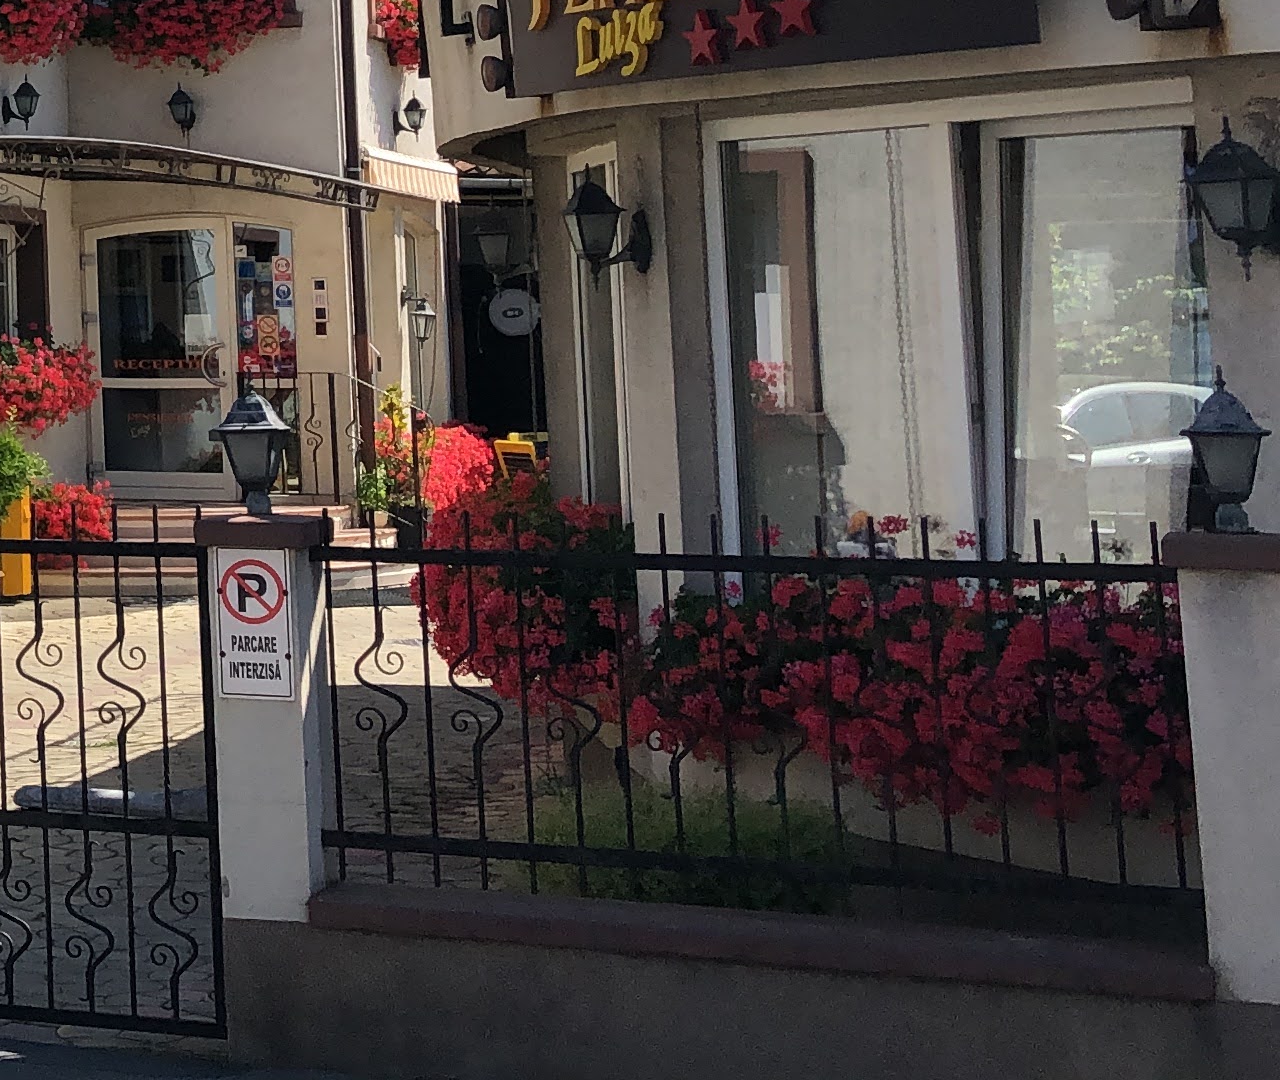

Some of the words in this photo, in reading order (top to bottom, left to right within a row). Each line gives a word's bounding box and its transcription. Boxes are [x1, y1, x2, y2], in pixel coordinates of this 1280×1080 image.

[576, 2, 662, 77] Luiza
[237, 572, 267, 613] P
[231, 634, 278, 654] PARCARE
